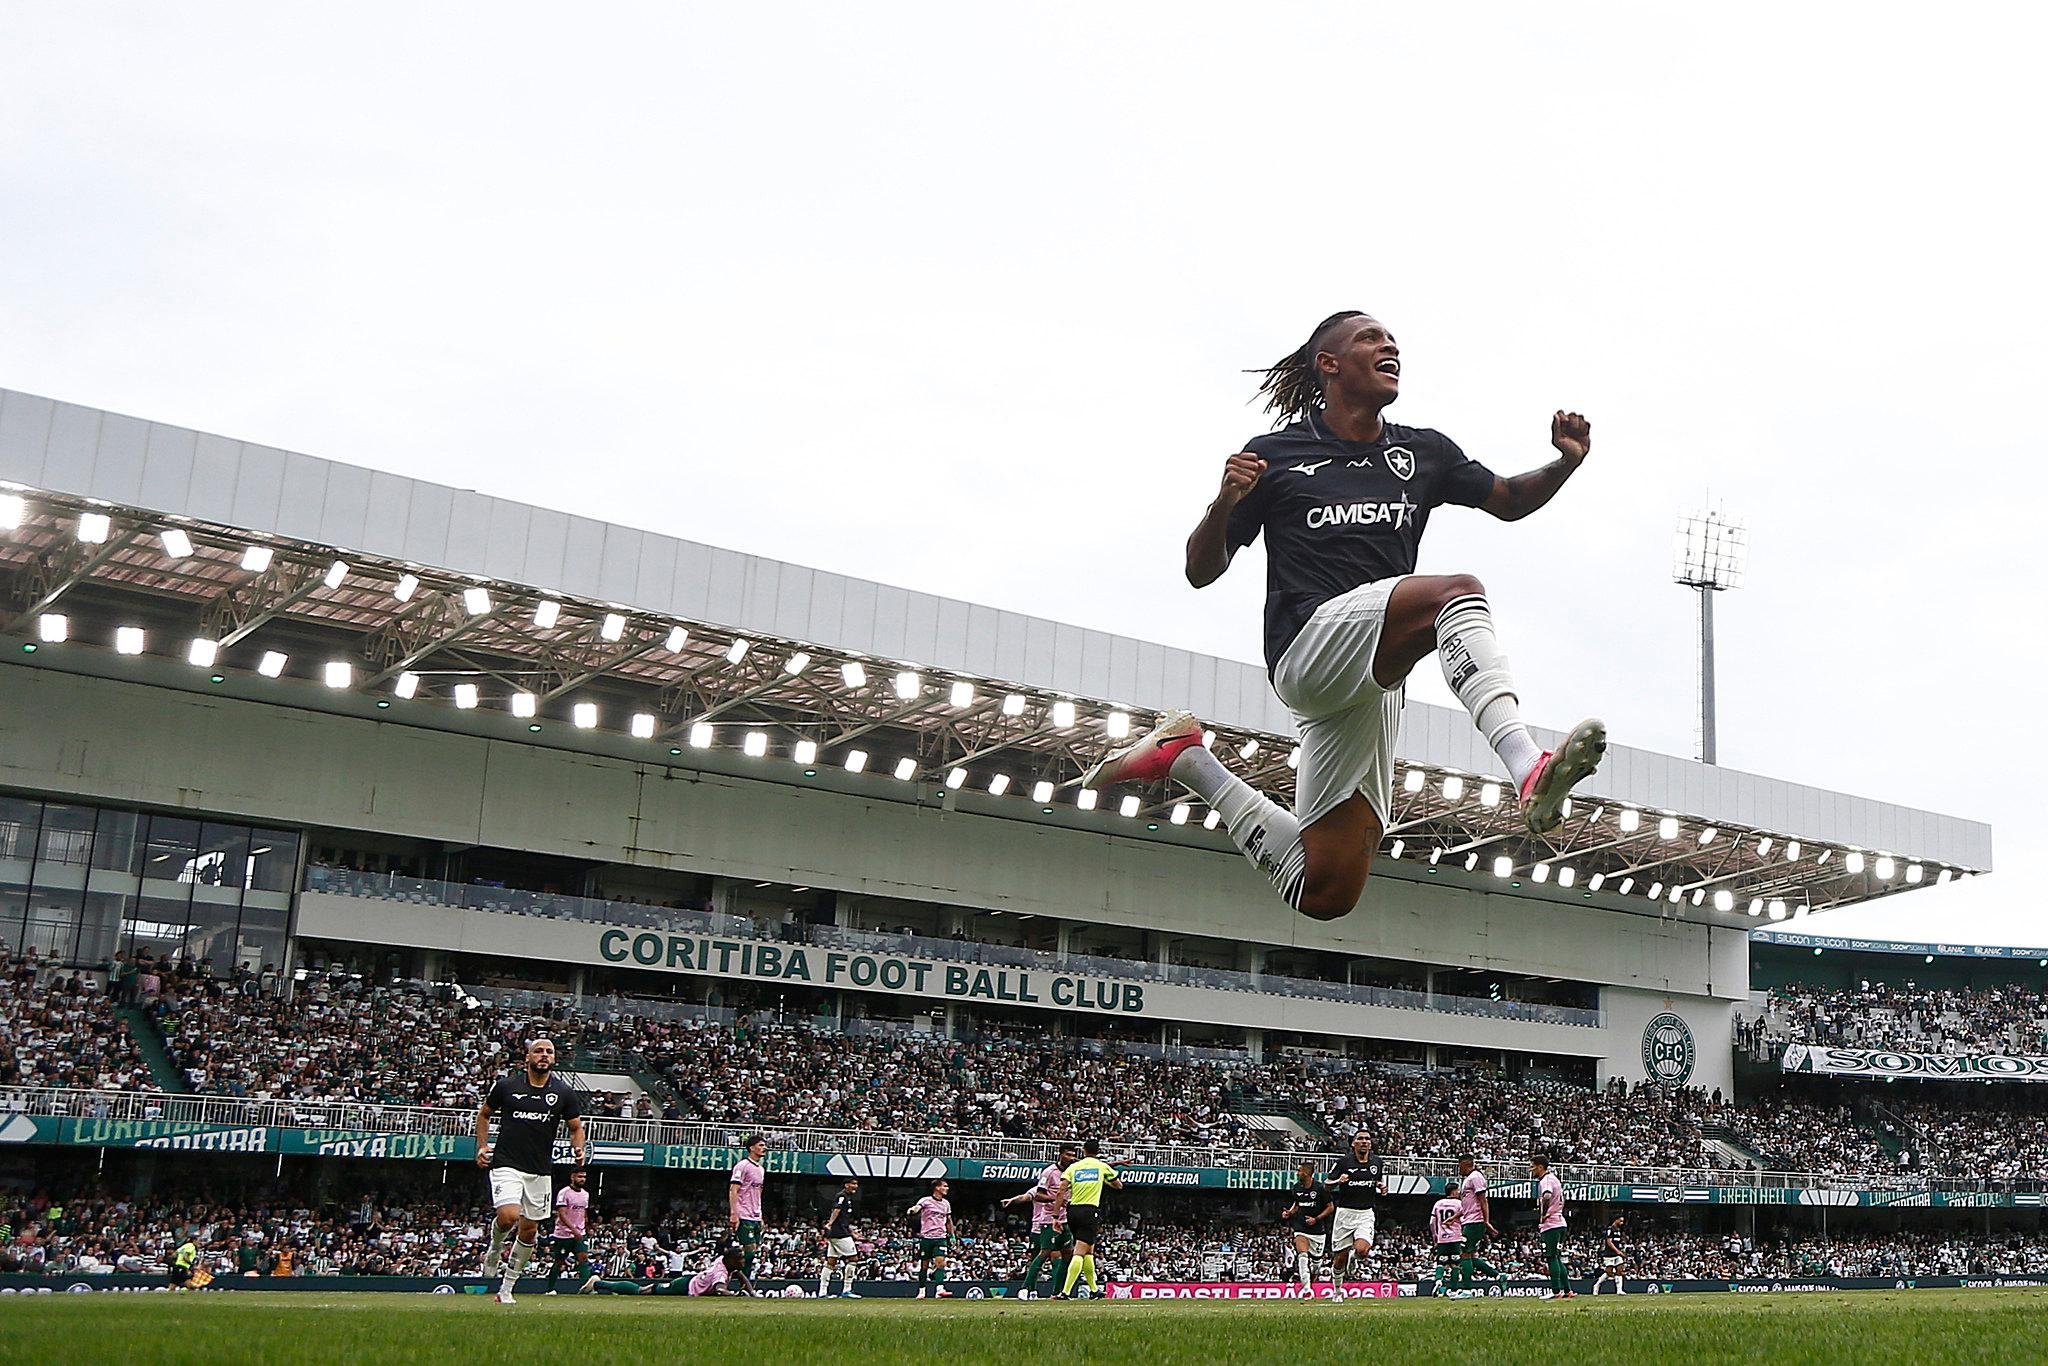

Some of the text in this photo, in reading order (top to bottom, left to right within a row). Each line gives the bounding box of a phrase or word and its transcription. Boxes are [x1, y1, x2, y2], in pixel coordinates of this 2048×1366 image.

[1306, 502, 1405, 531] CAMISA7
[1777, 933, 1848, 948] SILICON SILICON
[600, 929, 1144, 1013] CORITIBA FOOT BALL CLUB
[1655, 1042, 1683, 1062] CFC
[664, 1145, 802, 1174] GREEN ELL
[982, 1162, 1031, 1180] ESTÁDIO
[1121, 1169, 1156, 1184] COUTO
[1157, 1171, 1200, 1185] PEREIRA
[1226, 1168, 1285, 1190] GREEN
[1718, 1187, 1787, 1205] GREEN HELL
